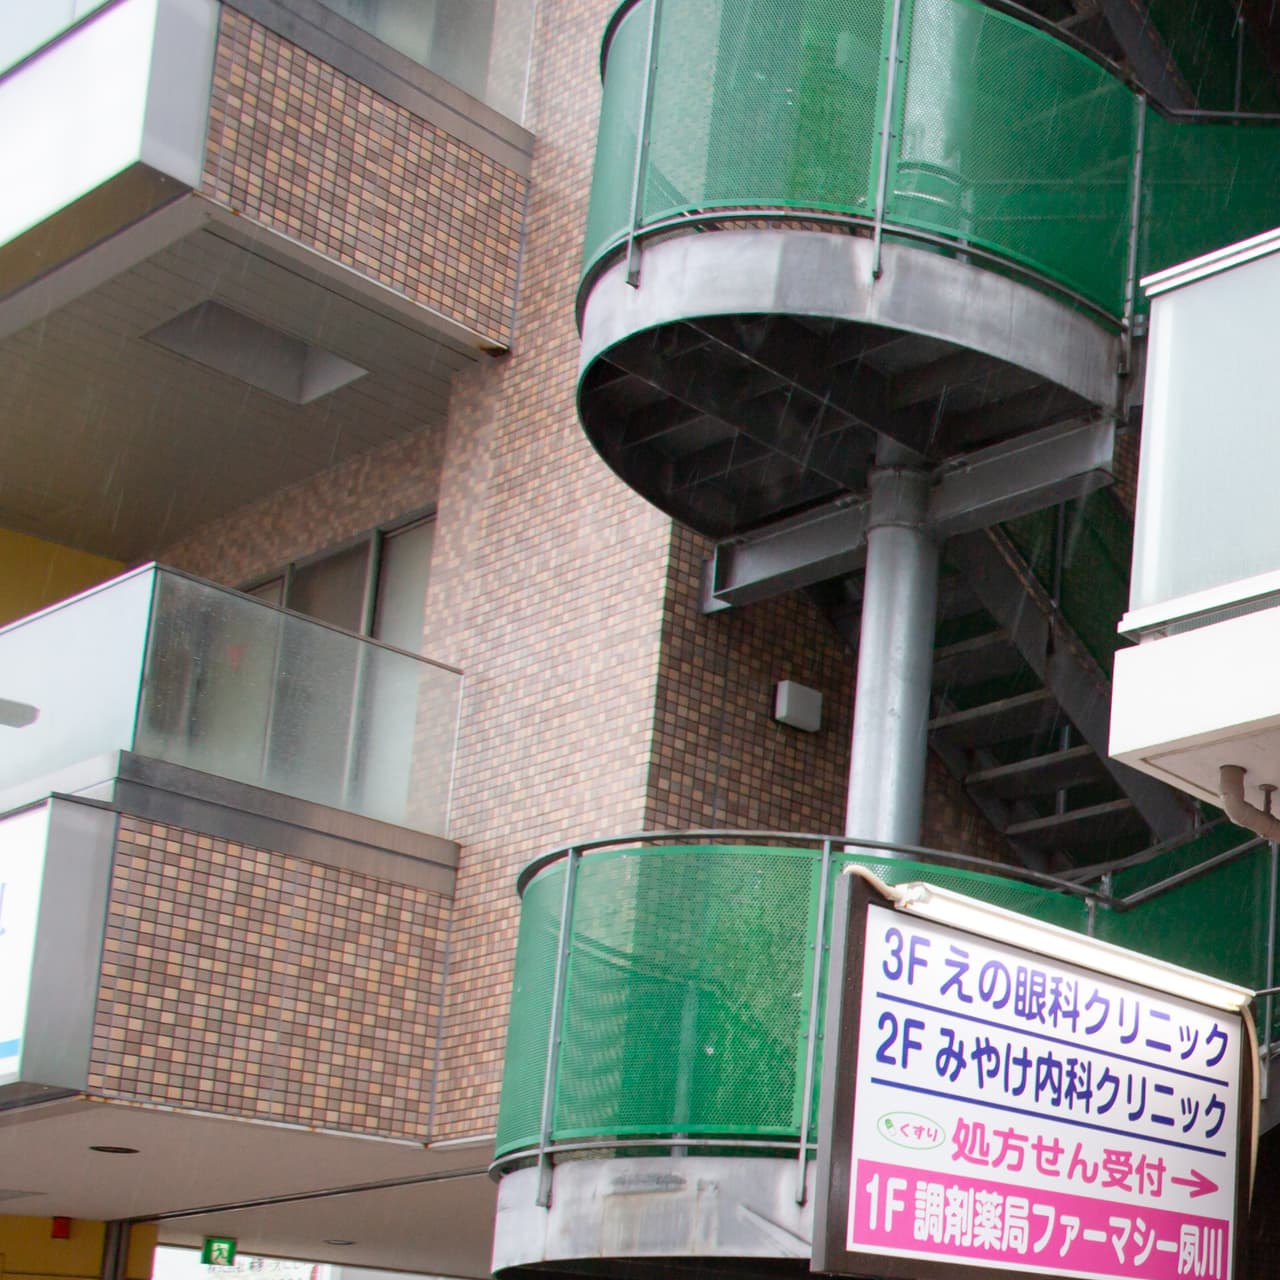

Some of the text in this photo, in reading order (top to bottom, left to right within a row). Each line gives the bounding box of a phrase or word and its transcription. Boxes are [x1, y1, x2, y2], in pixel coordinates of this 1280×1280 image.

[882, 927, 1229, 1067] 3F えの眼科クリニック
[876, 1011, 1227, 1139] 2F みやけ内科クリニック
[899, 1122, 938, 1142] くすり
[951, 1116, 1166, 1198] 処方せん受付
[866, 1173, 1224, 1280] 1F 調剤薬局ファーマシー夙川
